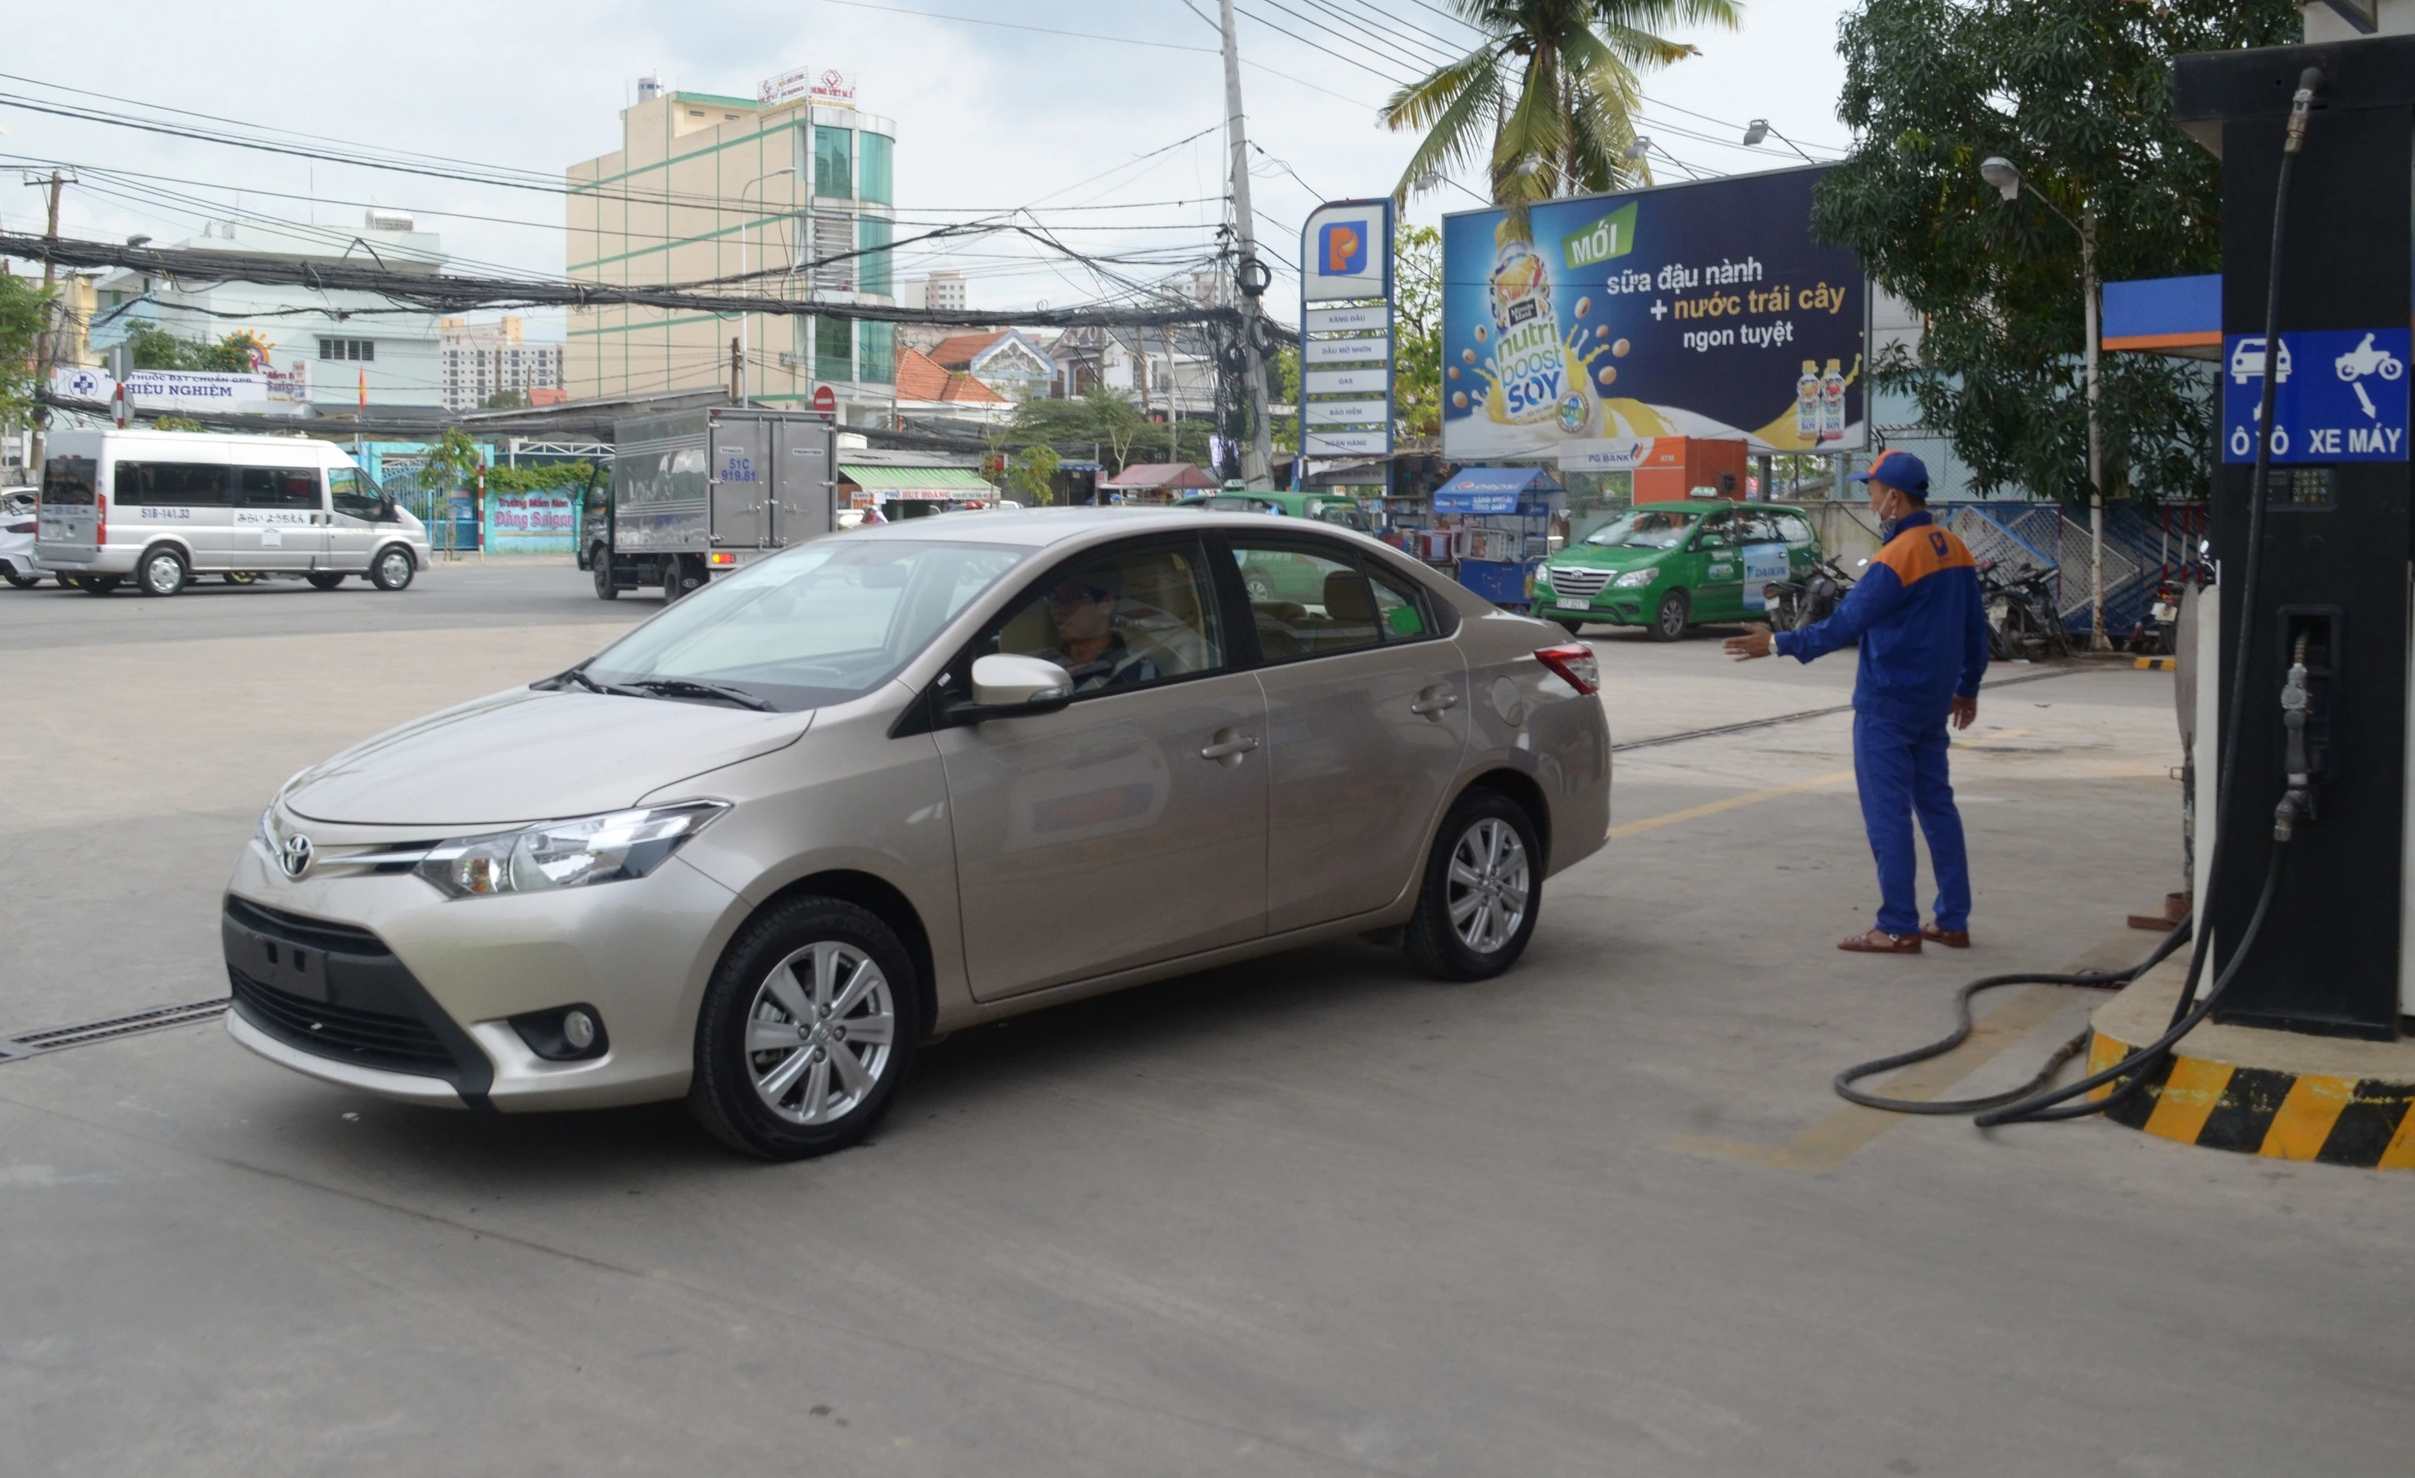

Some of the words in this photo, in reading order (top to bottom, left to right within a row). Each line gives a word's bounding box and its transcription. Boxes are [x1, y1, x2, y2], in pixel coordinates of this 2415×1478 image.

[1571, 219, 1618, 264] MỚI
[1607, 270, 1651, 295] sữa
[1657, 263, 1698, 294] đậu
[1705, 256, 1763, 285] nành
[1674, 291, 1741, 319] nước
[1749, 285, 1790, 314] trái
[1798, 282, 1846, 314] cây
[1498, 315, 1558, 363] nutri
[1683, 329, 1734, 352] ngon
[1740, 320, 1793, 348] tuyệt
[1501, 344, 1563, 389] boost
[169, 384, 233, 399] NGHIỆM
[1508, 371, 1561, 414] SOY
[2231, 425, 2250, 456] Ô
[2309, 429, 2342, 453] XE
[2348, 422, 2402, 453] MÁY
[729, 458, 750, 470] 51C
[1602, 454, 1630, 462] BANK
[1755, 567, 1786, 577] DAIKIN
